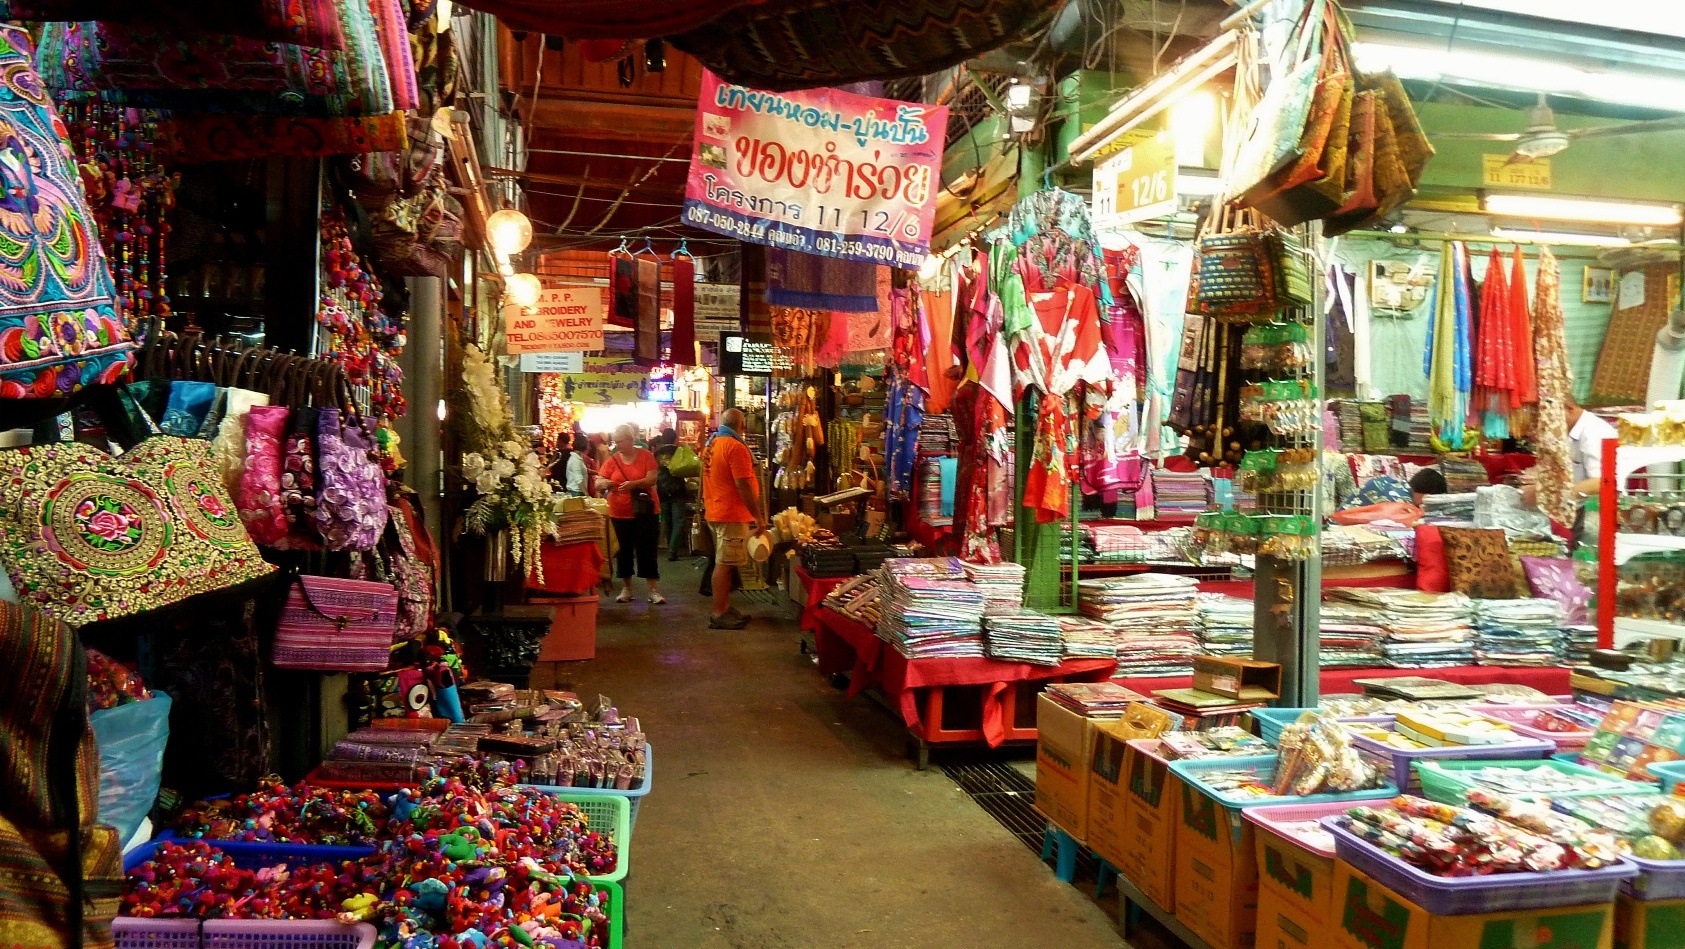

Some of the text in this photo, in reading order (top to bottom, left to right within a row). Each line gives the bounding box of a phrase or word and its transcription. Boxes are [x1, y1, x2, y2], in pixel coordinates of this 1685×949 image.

[717, 84, 927, 146] เทยนหอม-ปูนปั้น
[735, 140, 929, 206] ของชำร่วย
[1131, 169, 1167, 207] 12/6
[688, 206, 765, 239] 087-050-2844
[816, 237, 894, 261] 081-259-3790
[705, 175, 921, 237] โครงการ 11 12/6
[514, 318, 593, 330] AND EWELRY
[520, 305, 587, 316] EBROIDERY
